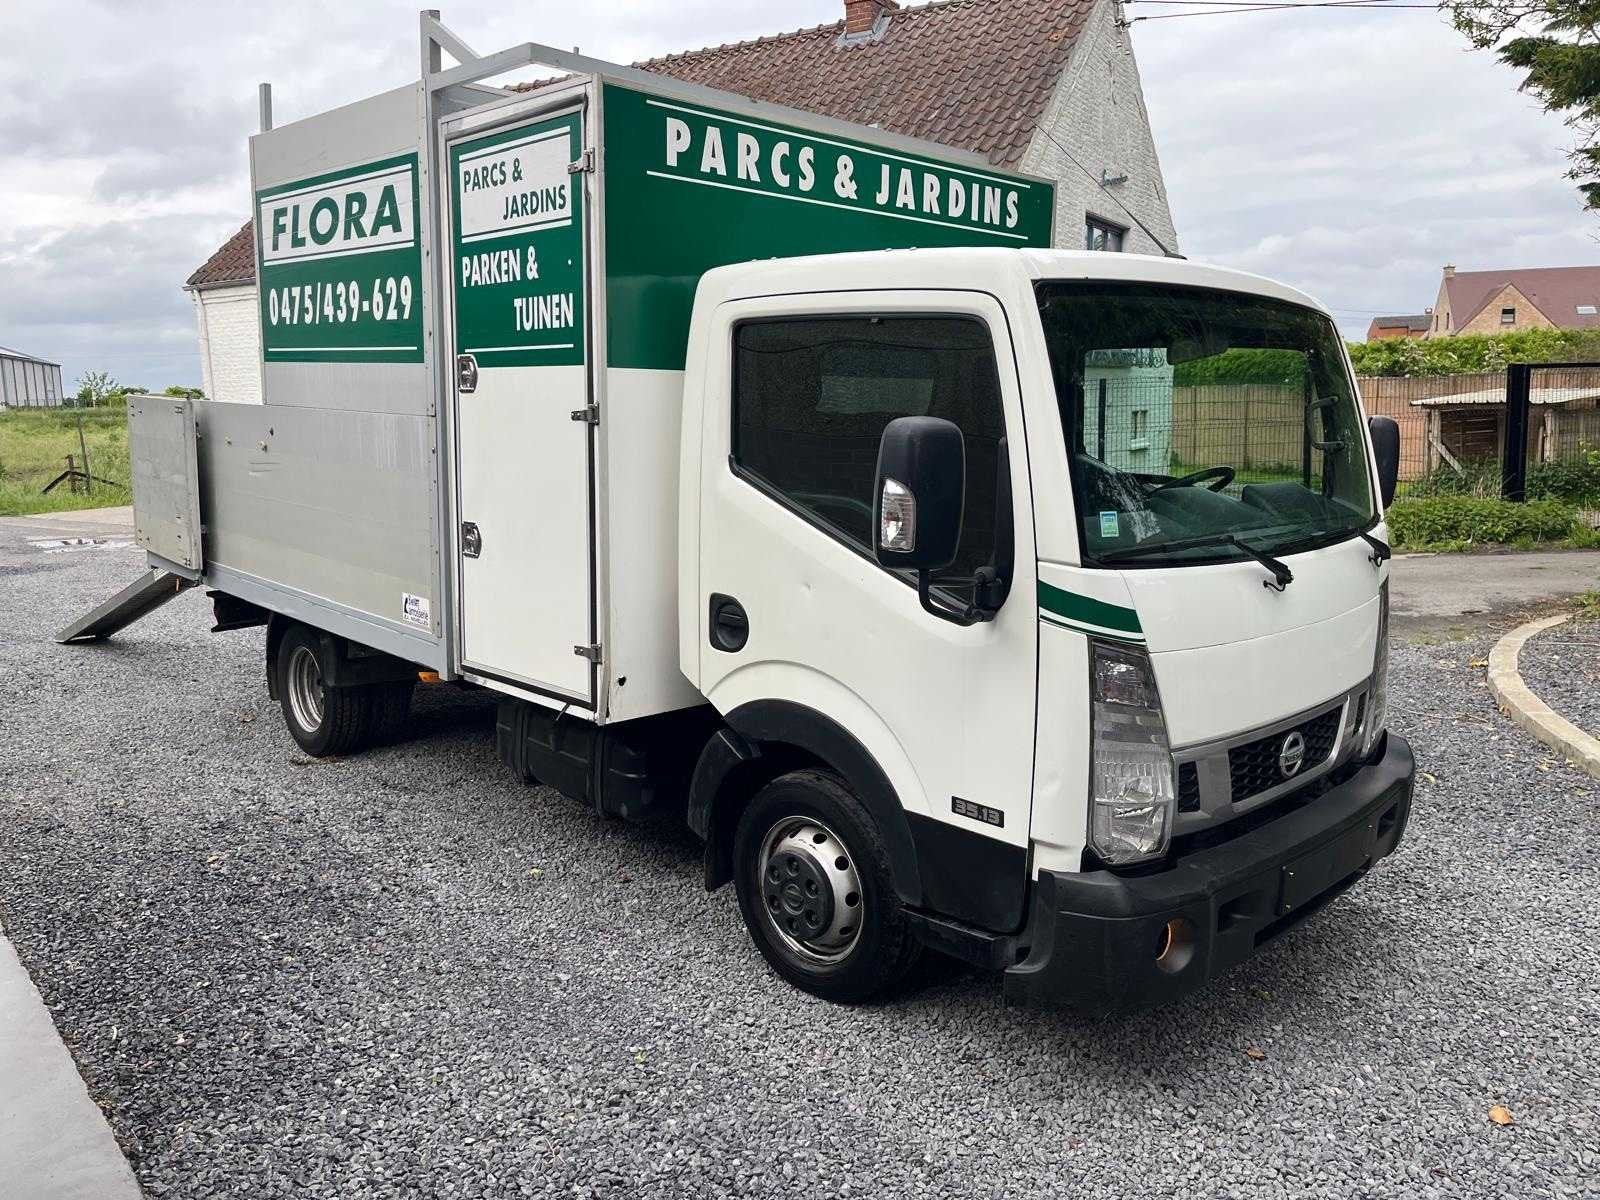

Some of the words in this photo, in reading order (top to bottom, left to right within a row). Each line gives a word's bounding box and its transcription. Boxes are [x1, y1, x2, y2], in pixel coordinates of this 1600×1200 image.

[463, 161, 507, 193] PARCS
[512, 157, 523, 182] &
[666, 117, 815, 192] PARCS
[834, 154, 858, 200] &
[876, 163, 1019, 228] JARDINS
[271, 184, 402, 252] FLORA
[503, 184, 567, 220] JARDINS
[462, 248, 521, 288] PARKEN
[526, 246, 539, 279] &
[269, 275, 412, 326] 0475/439-629
[513, 292, 574, 331] TUINEN
[954, 799, 1000, 825] 35.13
